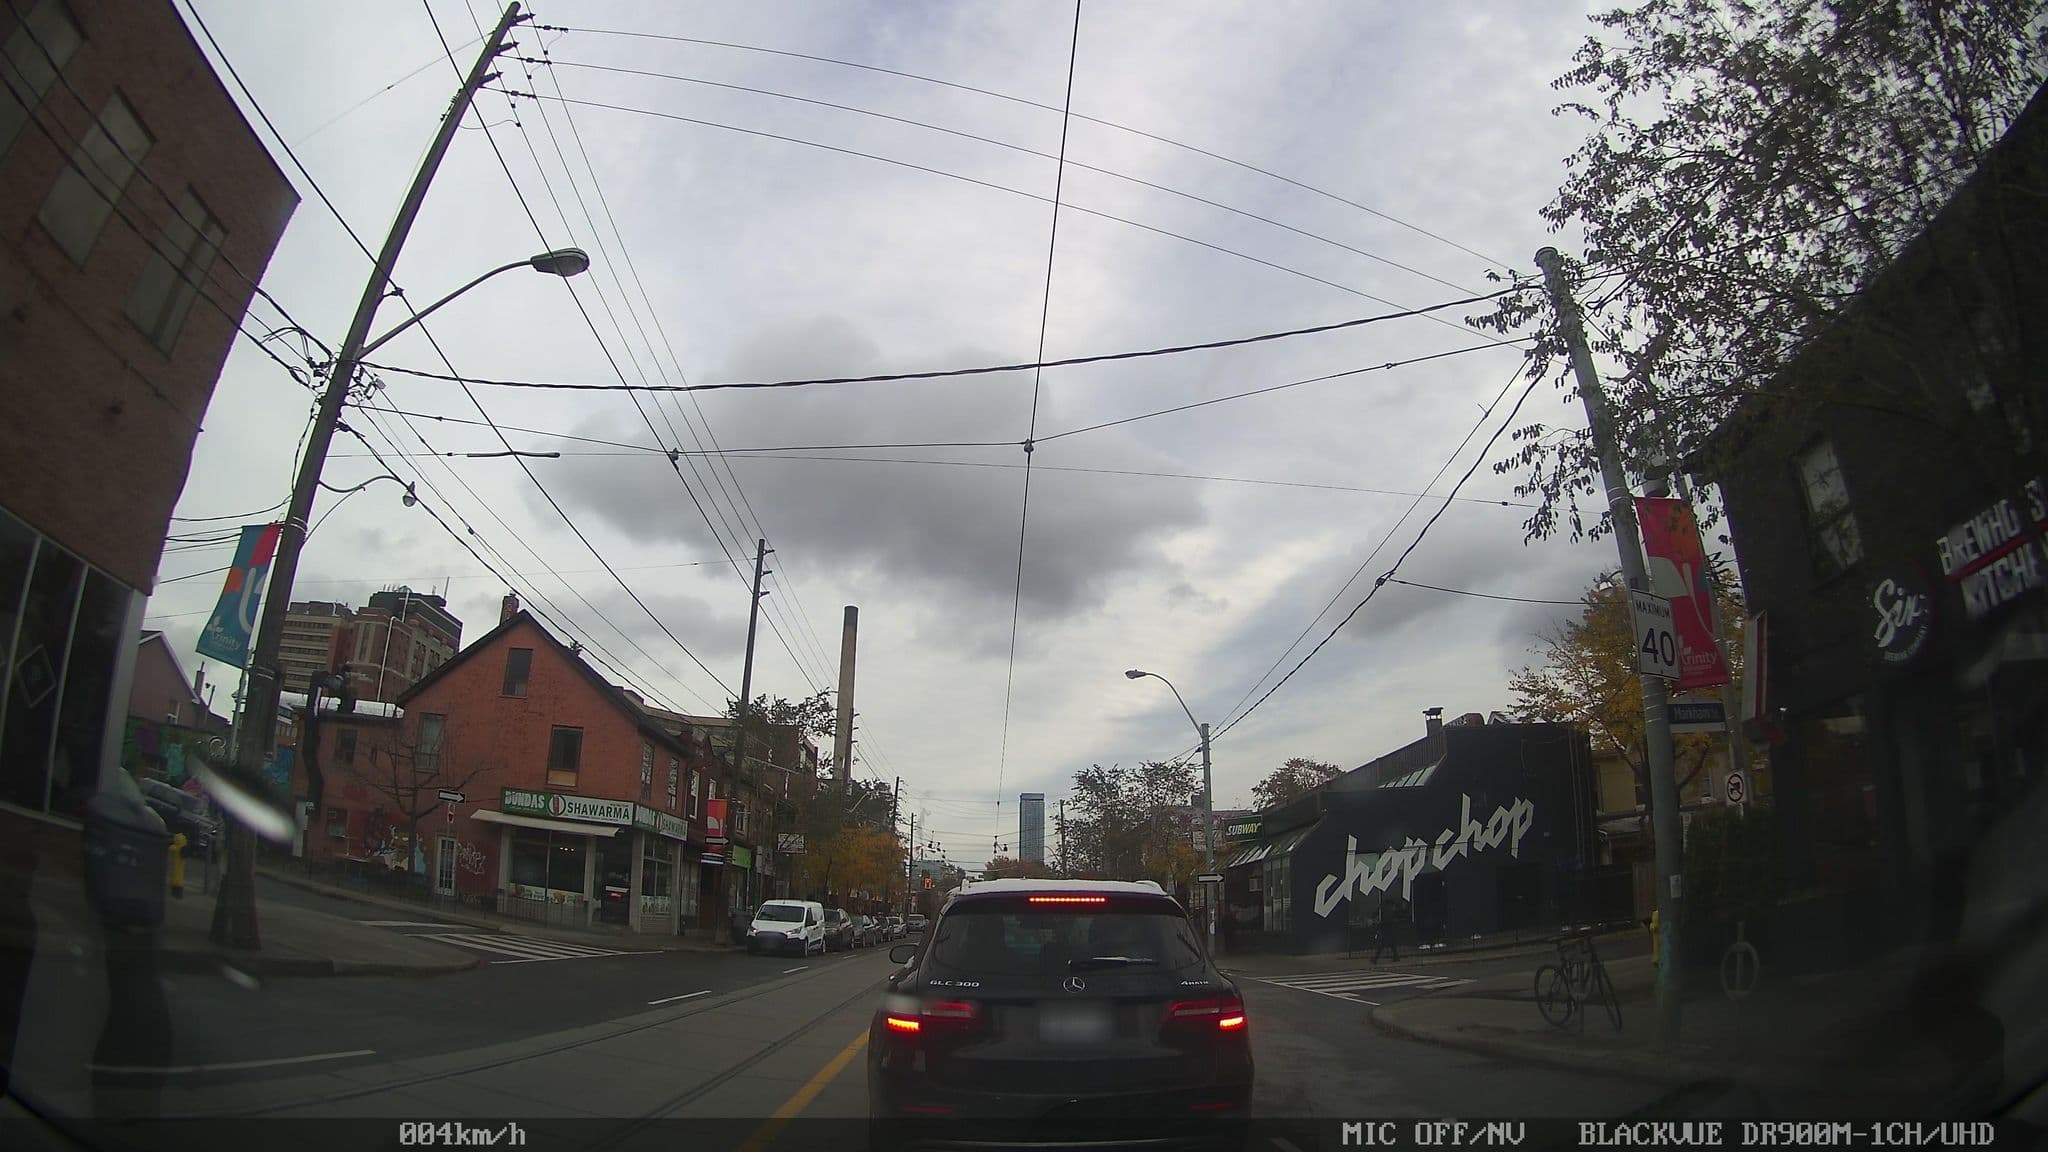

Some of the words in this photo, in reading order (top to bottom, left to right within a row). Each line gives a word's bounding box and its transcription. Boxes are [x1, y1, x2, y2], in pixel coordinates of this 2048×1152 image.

[1635, 599, 1671, 620] MAXIMUM
[1641, 628, 1676, 667] 40
[504, 790, 546, 810] DUNDAS
[567, 802, 630, 821] SHAWARMA
[1226, 823, 1260, 836] SUBWAY
[1313, 834, 1428, 918] chop
[1432, 792, 1536, 871] chop
[929, 979, 953, 987] GLC
[954, 980, 980, 988] 300
